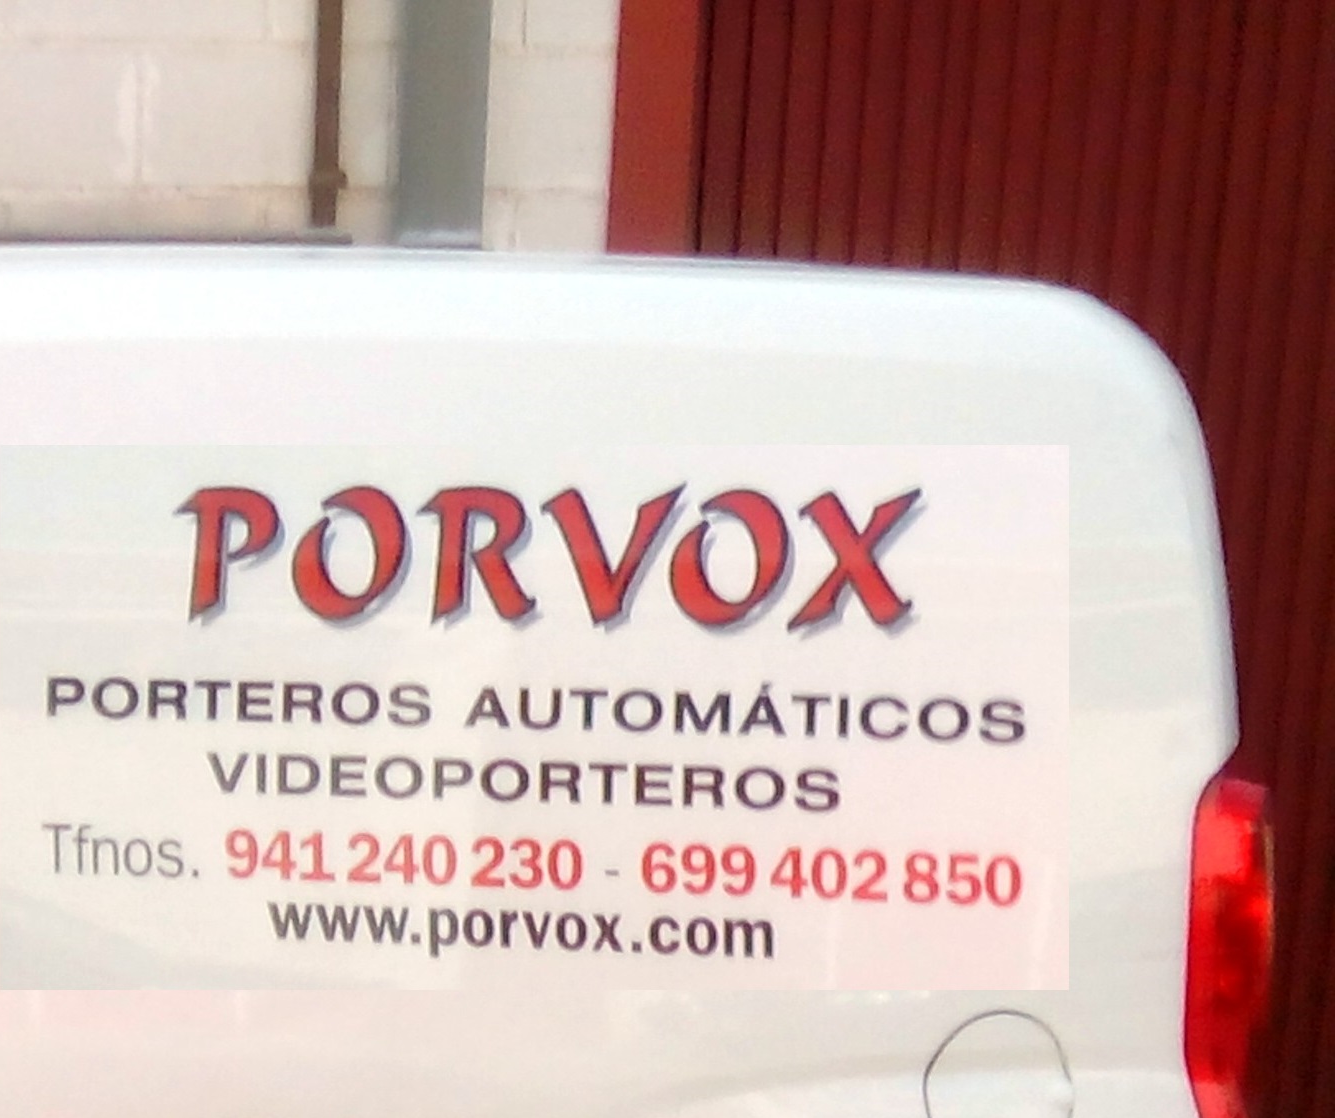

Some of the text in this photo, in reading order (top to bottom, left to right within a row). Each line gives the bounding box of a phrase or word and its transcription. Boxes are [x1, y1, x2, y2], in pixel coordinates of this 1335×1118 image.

[175, 482, 924, 635] PORVOX
[45, 675, 1027, 745] PORTEROS AUTOMÁTICOS
[207, 751, 842, 814] VIDEOPORTEROS
[42, 822, 201, 880] Tfnos.
[224, 828, 336, 883] 941
[345, 831, 459, 888] 240
[470, 835, 584, 892] 230
[640, 841, 758, 898] 699
[769, 845, 889, 903] 402
[902, 851, 1024, 908] 850
[267, 898, 776, 960] www.porvox.com
